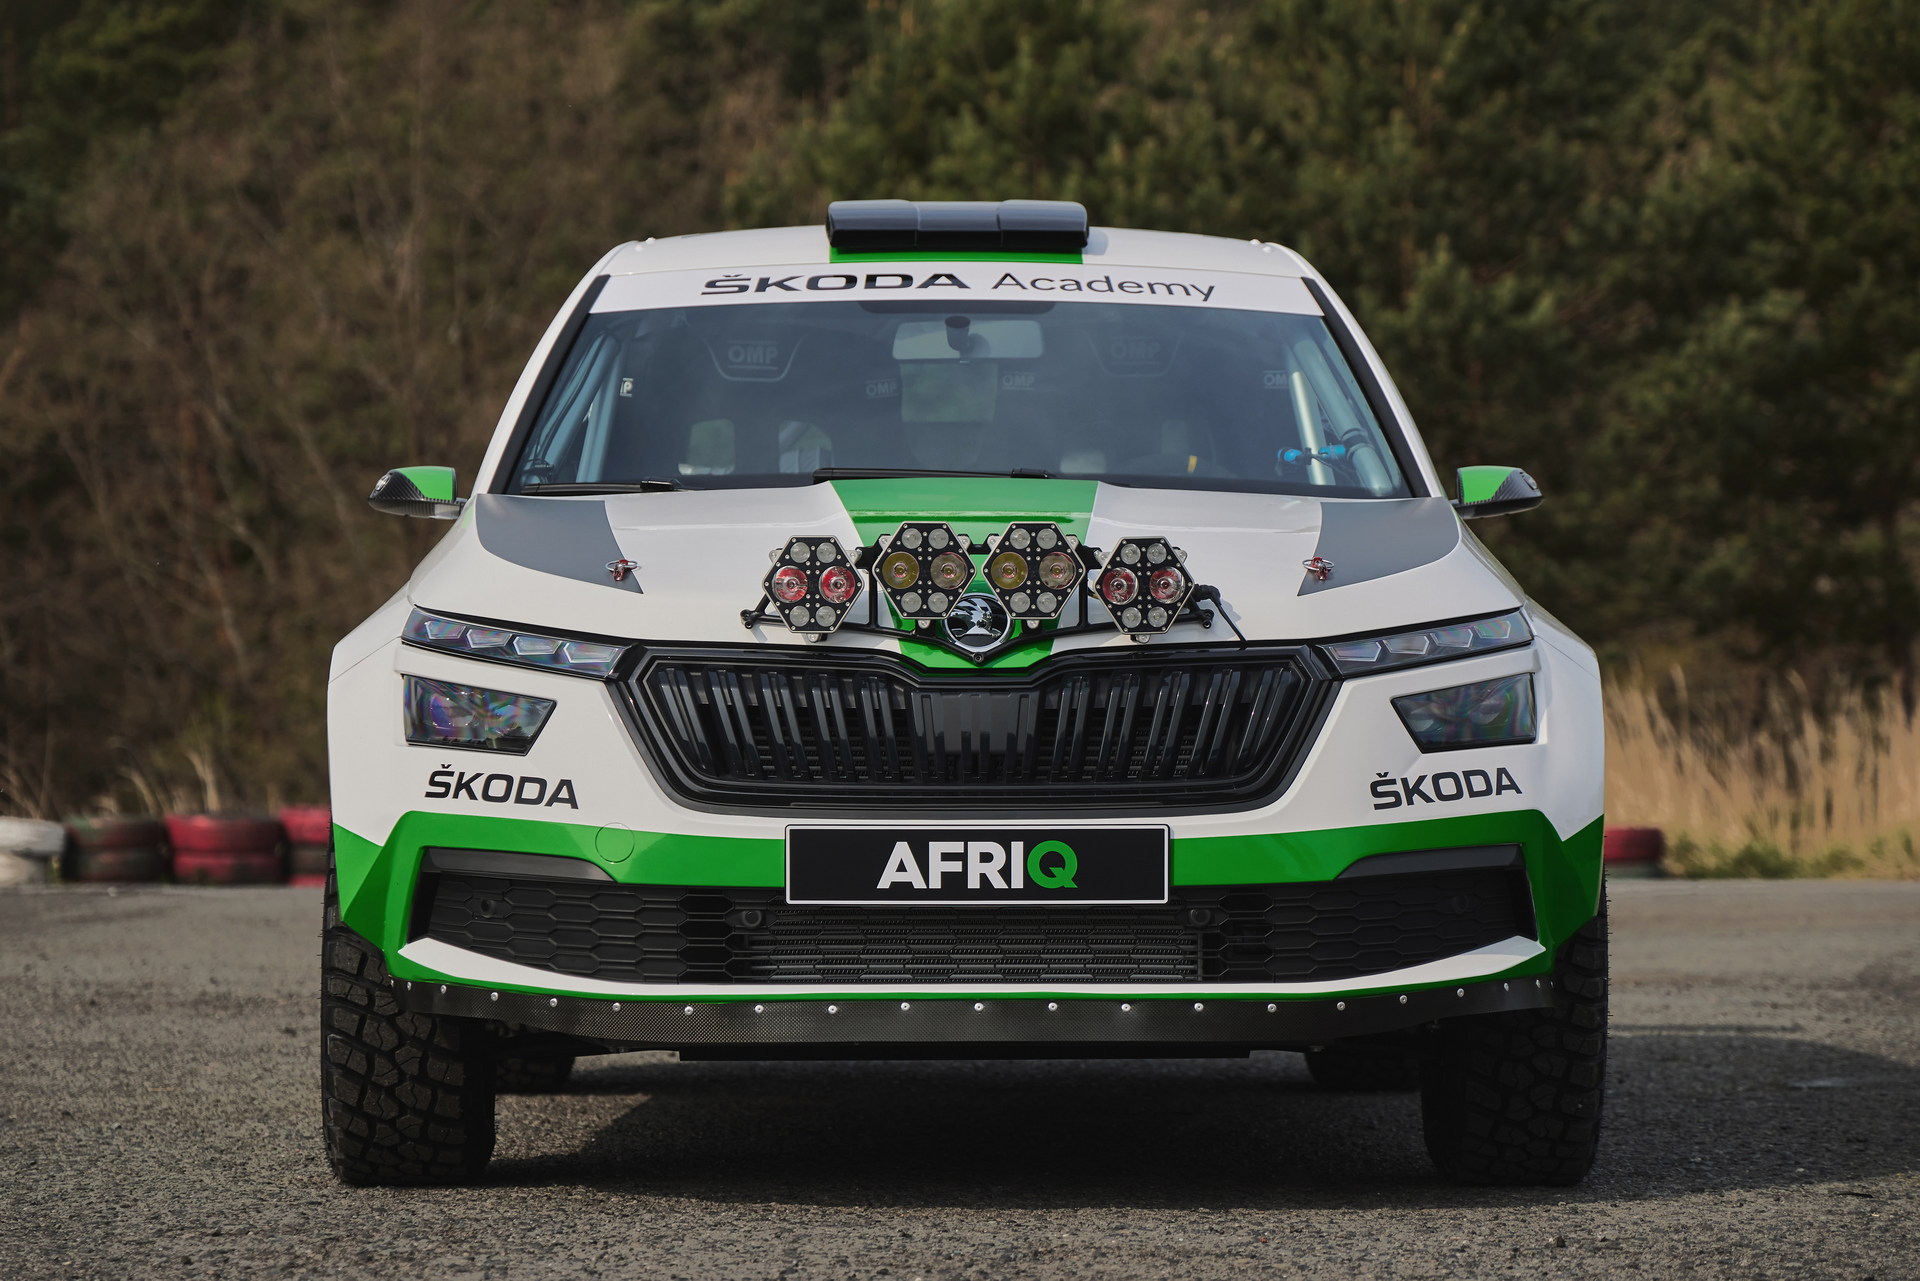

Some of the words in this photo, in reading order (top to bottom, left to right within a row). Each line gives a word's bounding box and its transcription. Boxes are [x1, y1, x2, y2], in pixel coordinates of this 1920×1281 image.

[701, 273, 970, 295] ŠKODA
[992, 273, 1215, 302] Academy
[728, 344, 777, 363] OMP
[1110, 341, 1160, 360] OMP
[866, 383, 896, 396] OMP
[1003, 375, 1034, 387] OMP
[425, 764, 579, 809] ŠKODA
[1370, 768, 1522, 810] ŠKODA
[876, 840, 1078, 889] AFRIQ
